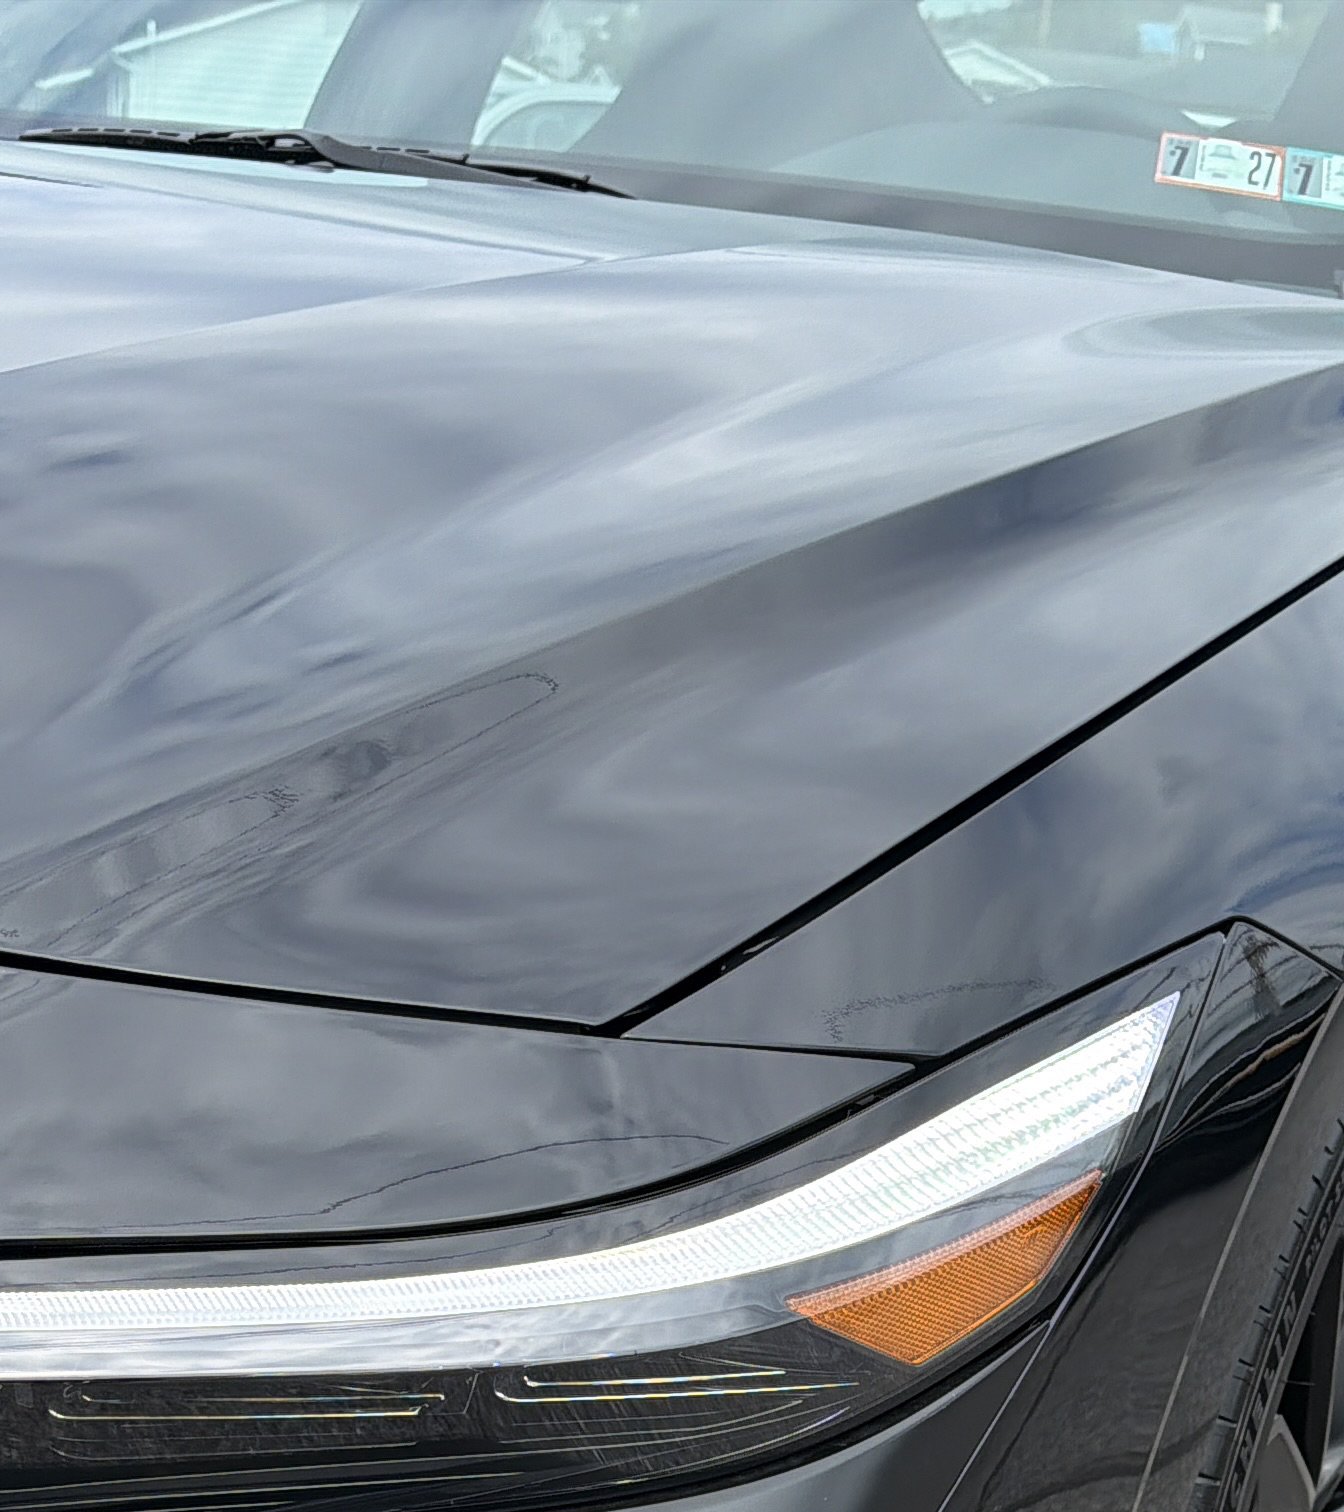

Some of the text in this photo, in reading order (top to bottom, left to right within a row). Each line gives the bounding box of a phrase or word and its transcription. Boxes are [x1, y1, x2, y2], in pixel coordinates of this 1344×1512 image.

[1172, 145, 1190, 177] 7
[1247, 150, 1277, 191] 27
[1297, 163, 1313, 196] 7
